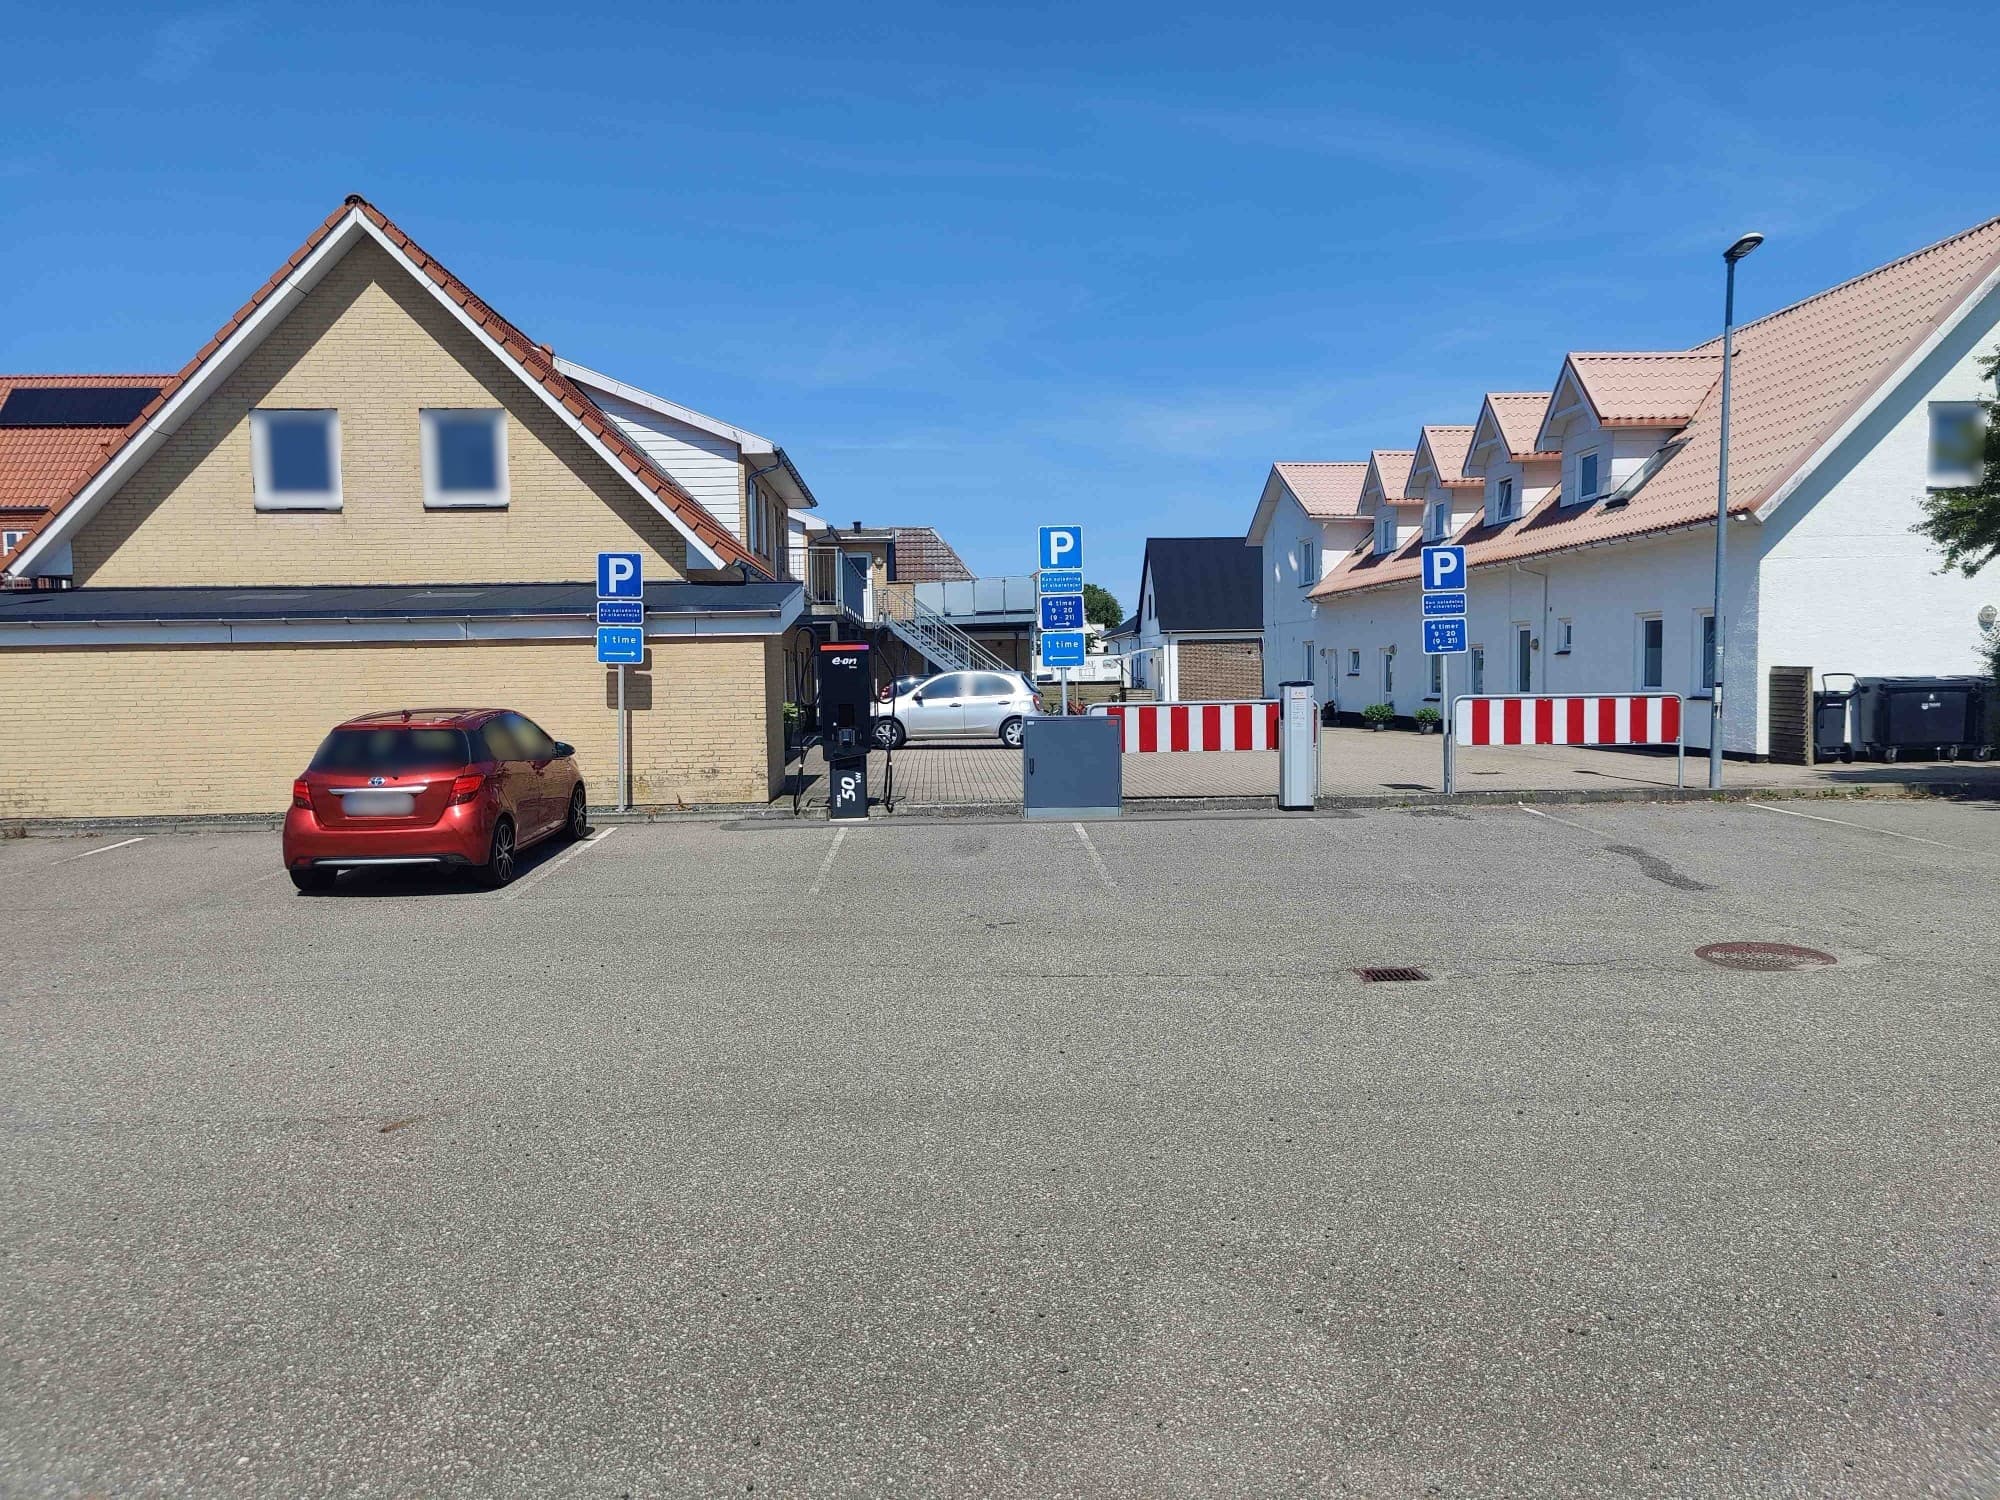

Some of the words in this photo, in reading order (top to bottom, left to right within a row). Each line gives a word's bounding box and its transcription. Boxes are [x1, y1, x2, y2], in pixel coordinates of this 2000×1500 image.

[1050, 531, 1074, 565] P
[608, 557, 634, 593] P
[1433, 551, 1458, 586] P
[604, 635, 607, 644] 1
[612, 635, 637, 644] time
[1056, 640, 1079, 648] time
[840, 776, 856, 802] 50
